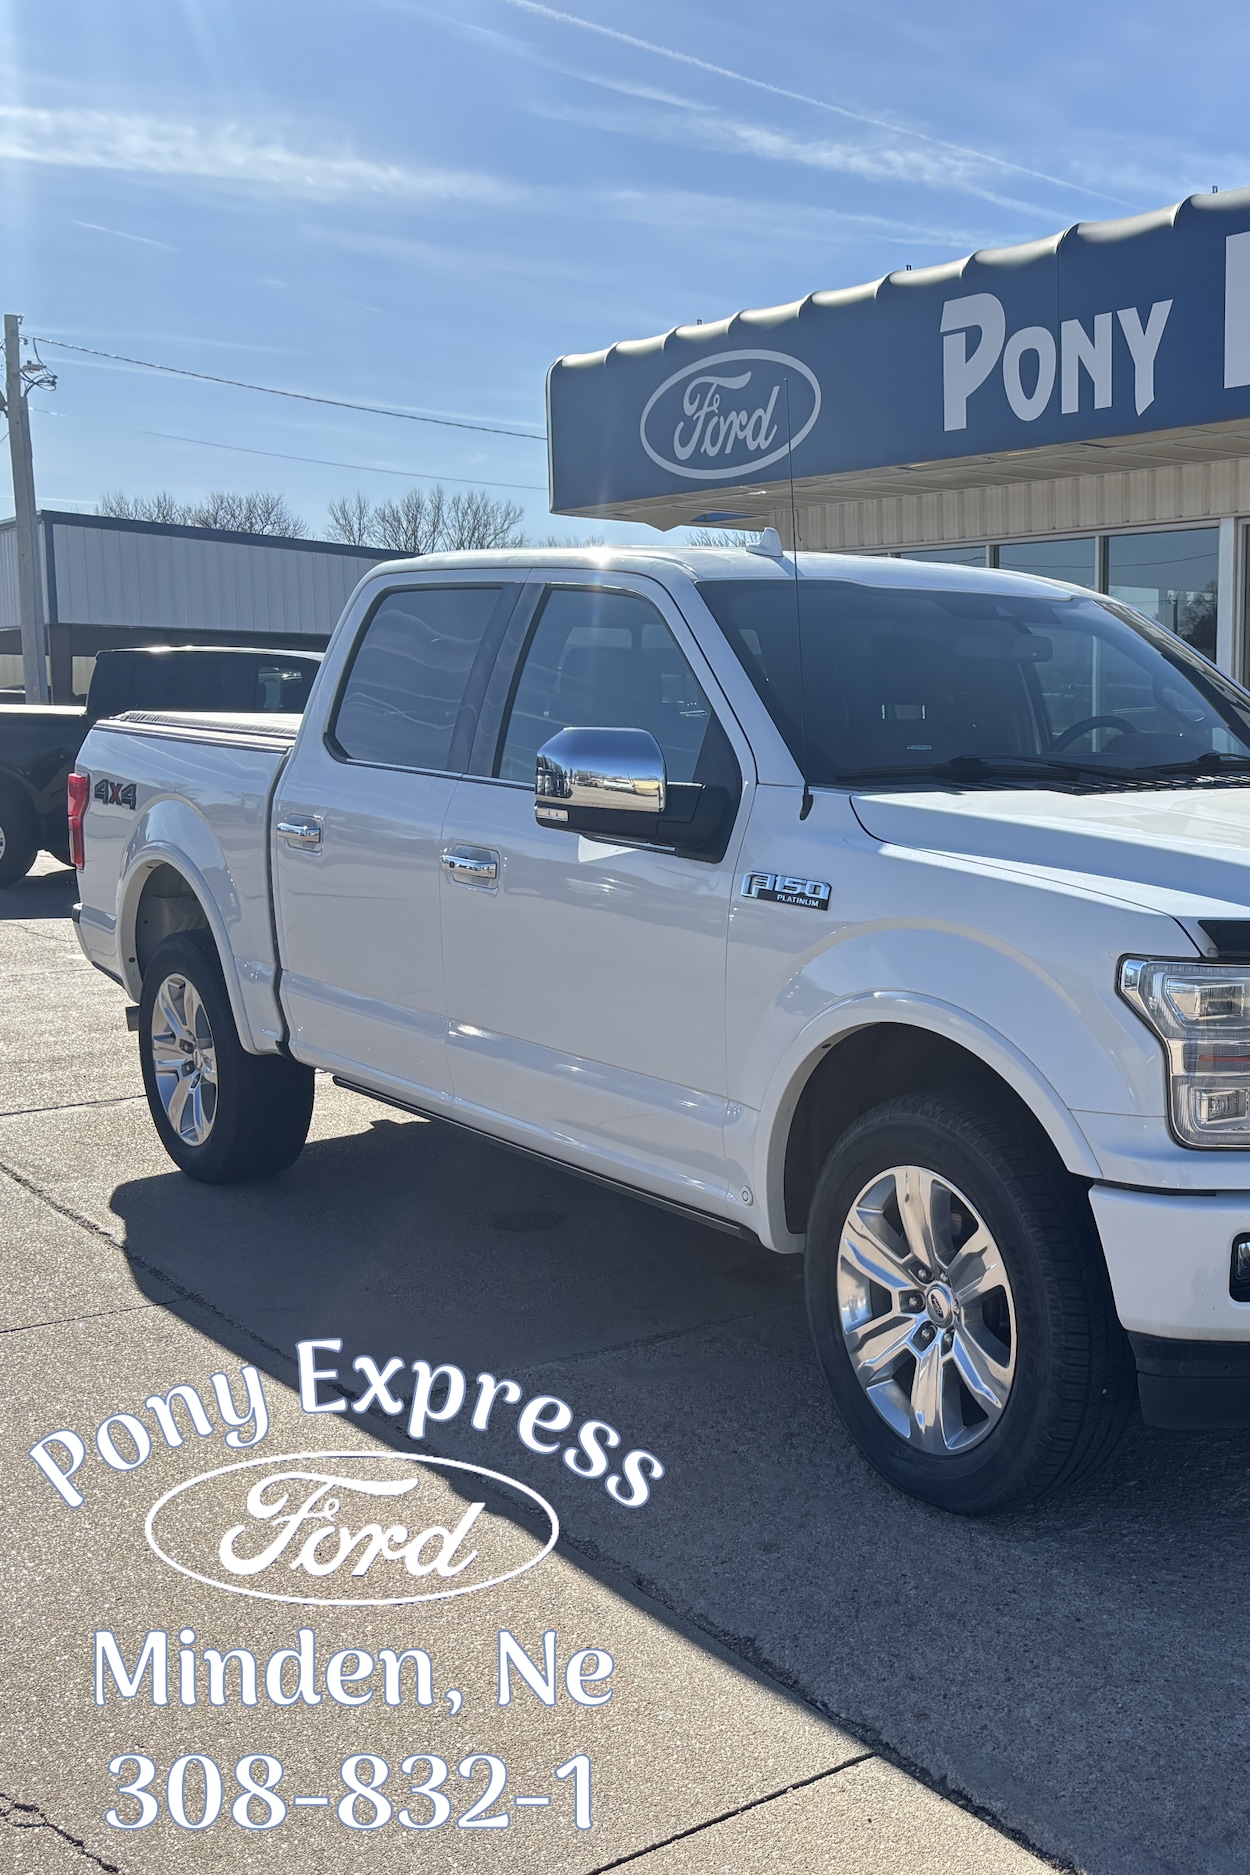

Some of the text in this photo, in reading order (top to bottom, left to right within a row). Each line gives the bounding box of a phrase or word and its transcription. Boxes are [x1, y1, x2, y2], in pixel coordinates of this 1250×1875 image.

[939, 293, 1173, 432] PONY
[673, 370, 780, 460] Ford
[777, 893, 819, 907] PLATINUM
